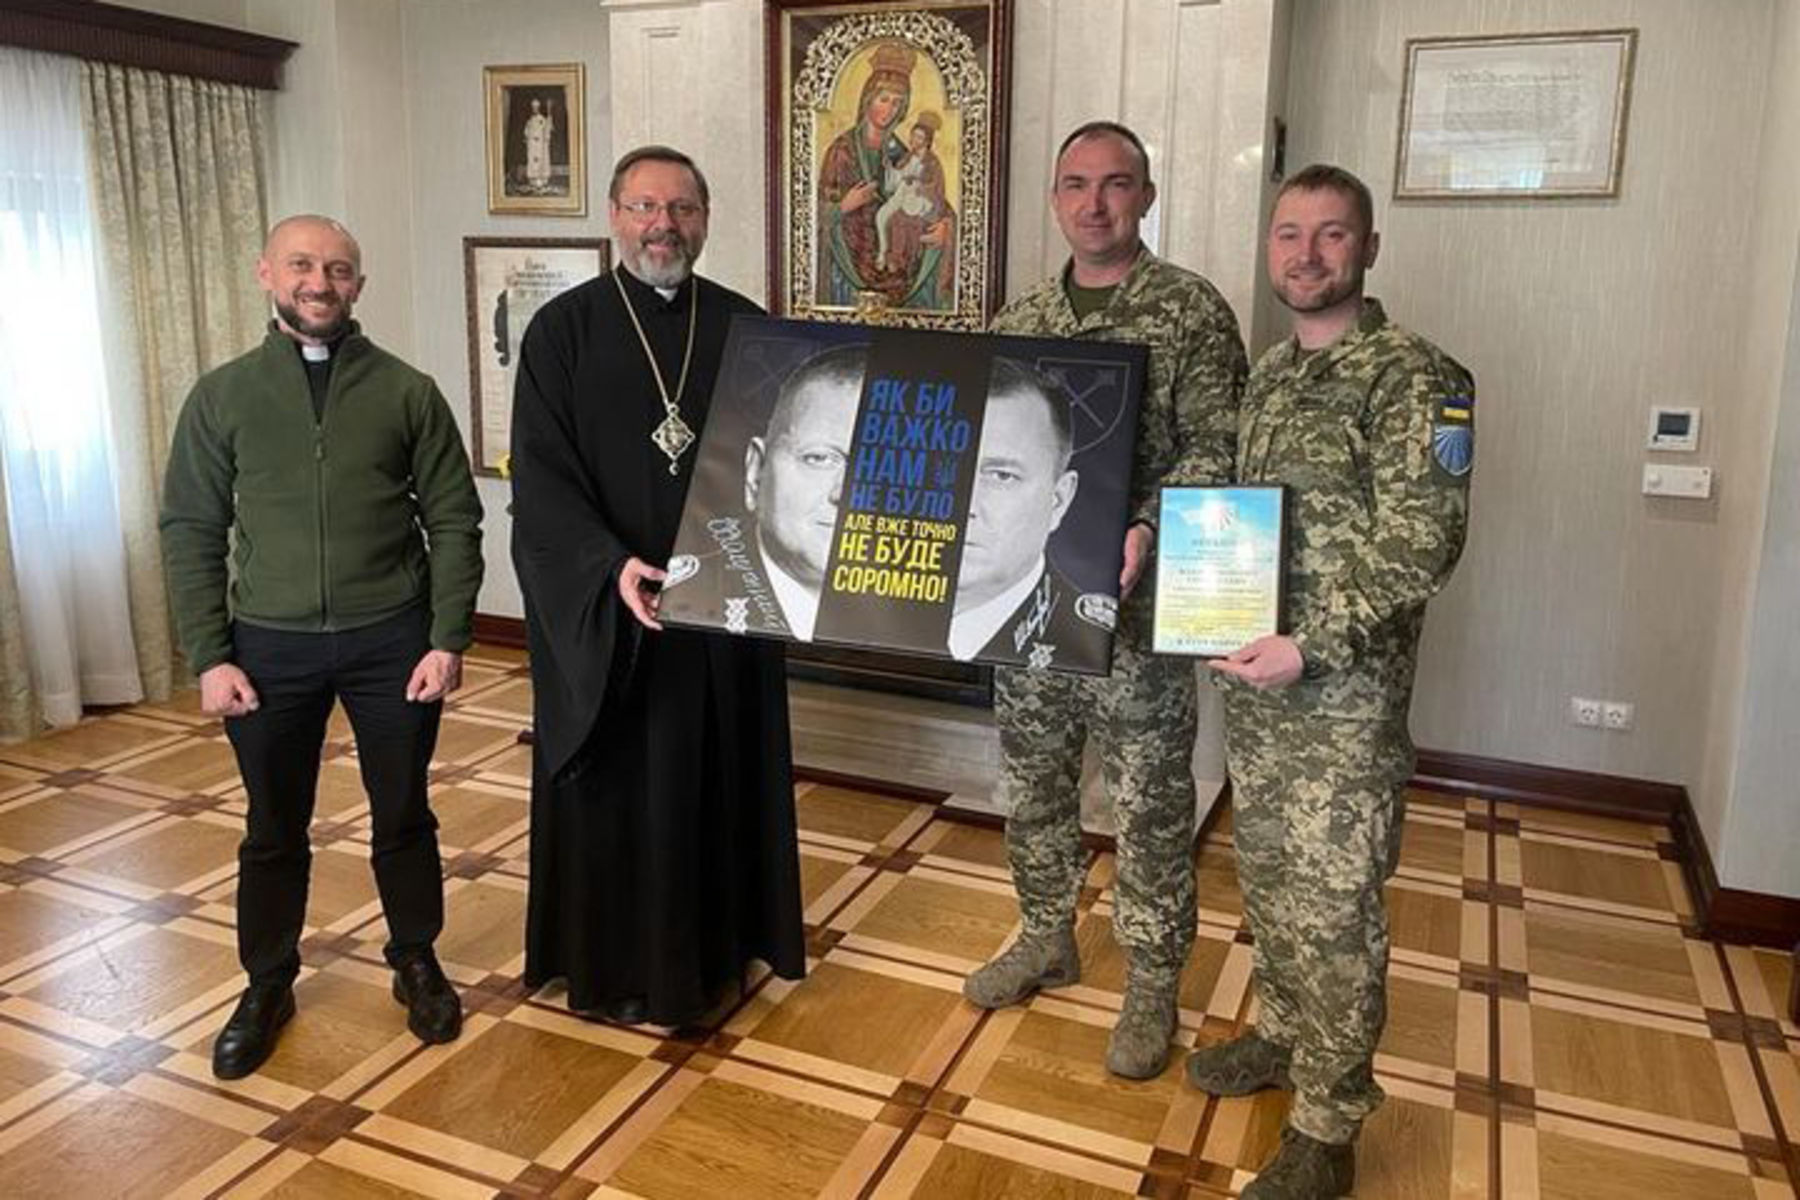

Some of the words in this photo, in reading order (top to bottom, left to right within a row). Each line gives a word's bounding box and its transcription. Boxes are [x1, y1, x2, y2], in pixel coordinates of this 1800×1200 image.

[869, 379, 908, 411] ЯК
[915, 383, 955, 416] БИ
[862, 411, 970, 451] ВАЖКО
[855, 448, 926, 487] НАМ
[850, 482, 880, 510] НЕ
[885, 487, 955, 519] БУЛО
[844, 514, 875, 531] АЛЕ
[876, 517, 909, 536] ВЖЕ
[912, 520, 957, 541] ТОЧНО
[838, 532, 872, 561] НЕ
[875, 537, 944, 570] БУДЕ
[833, 565, 948, 602] СОРОМНО!
